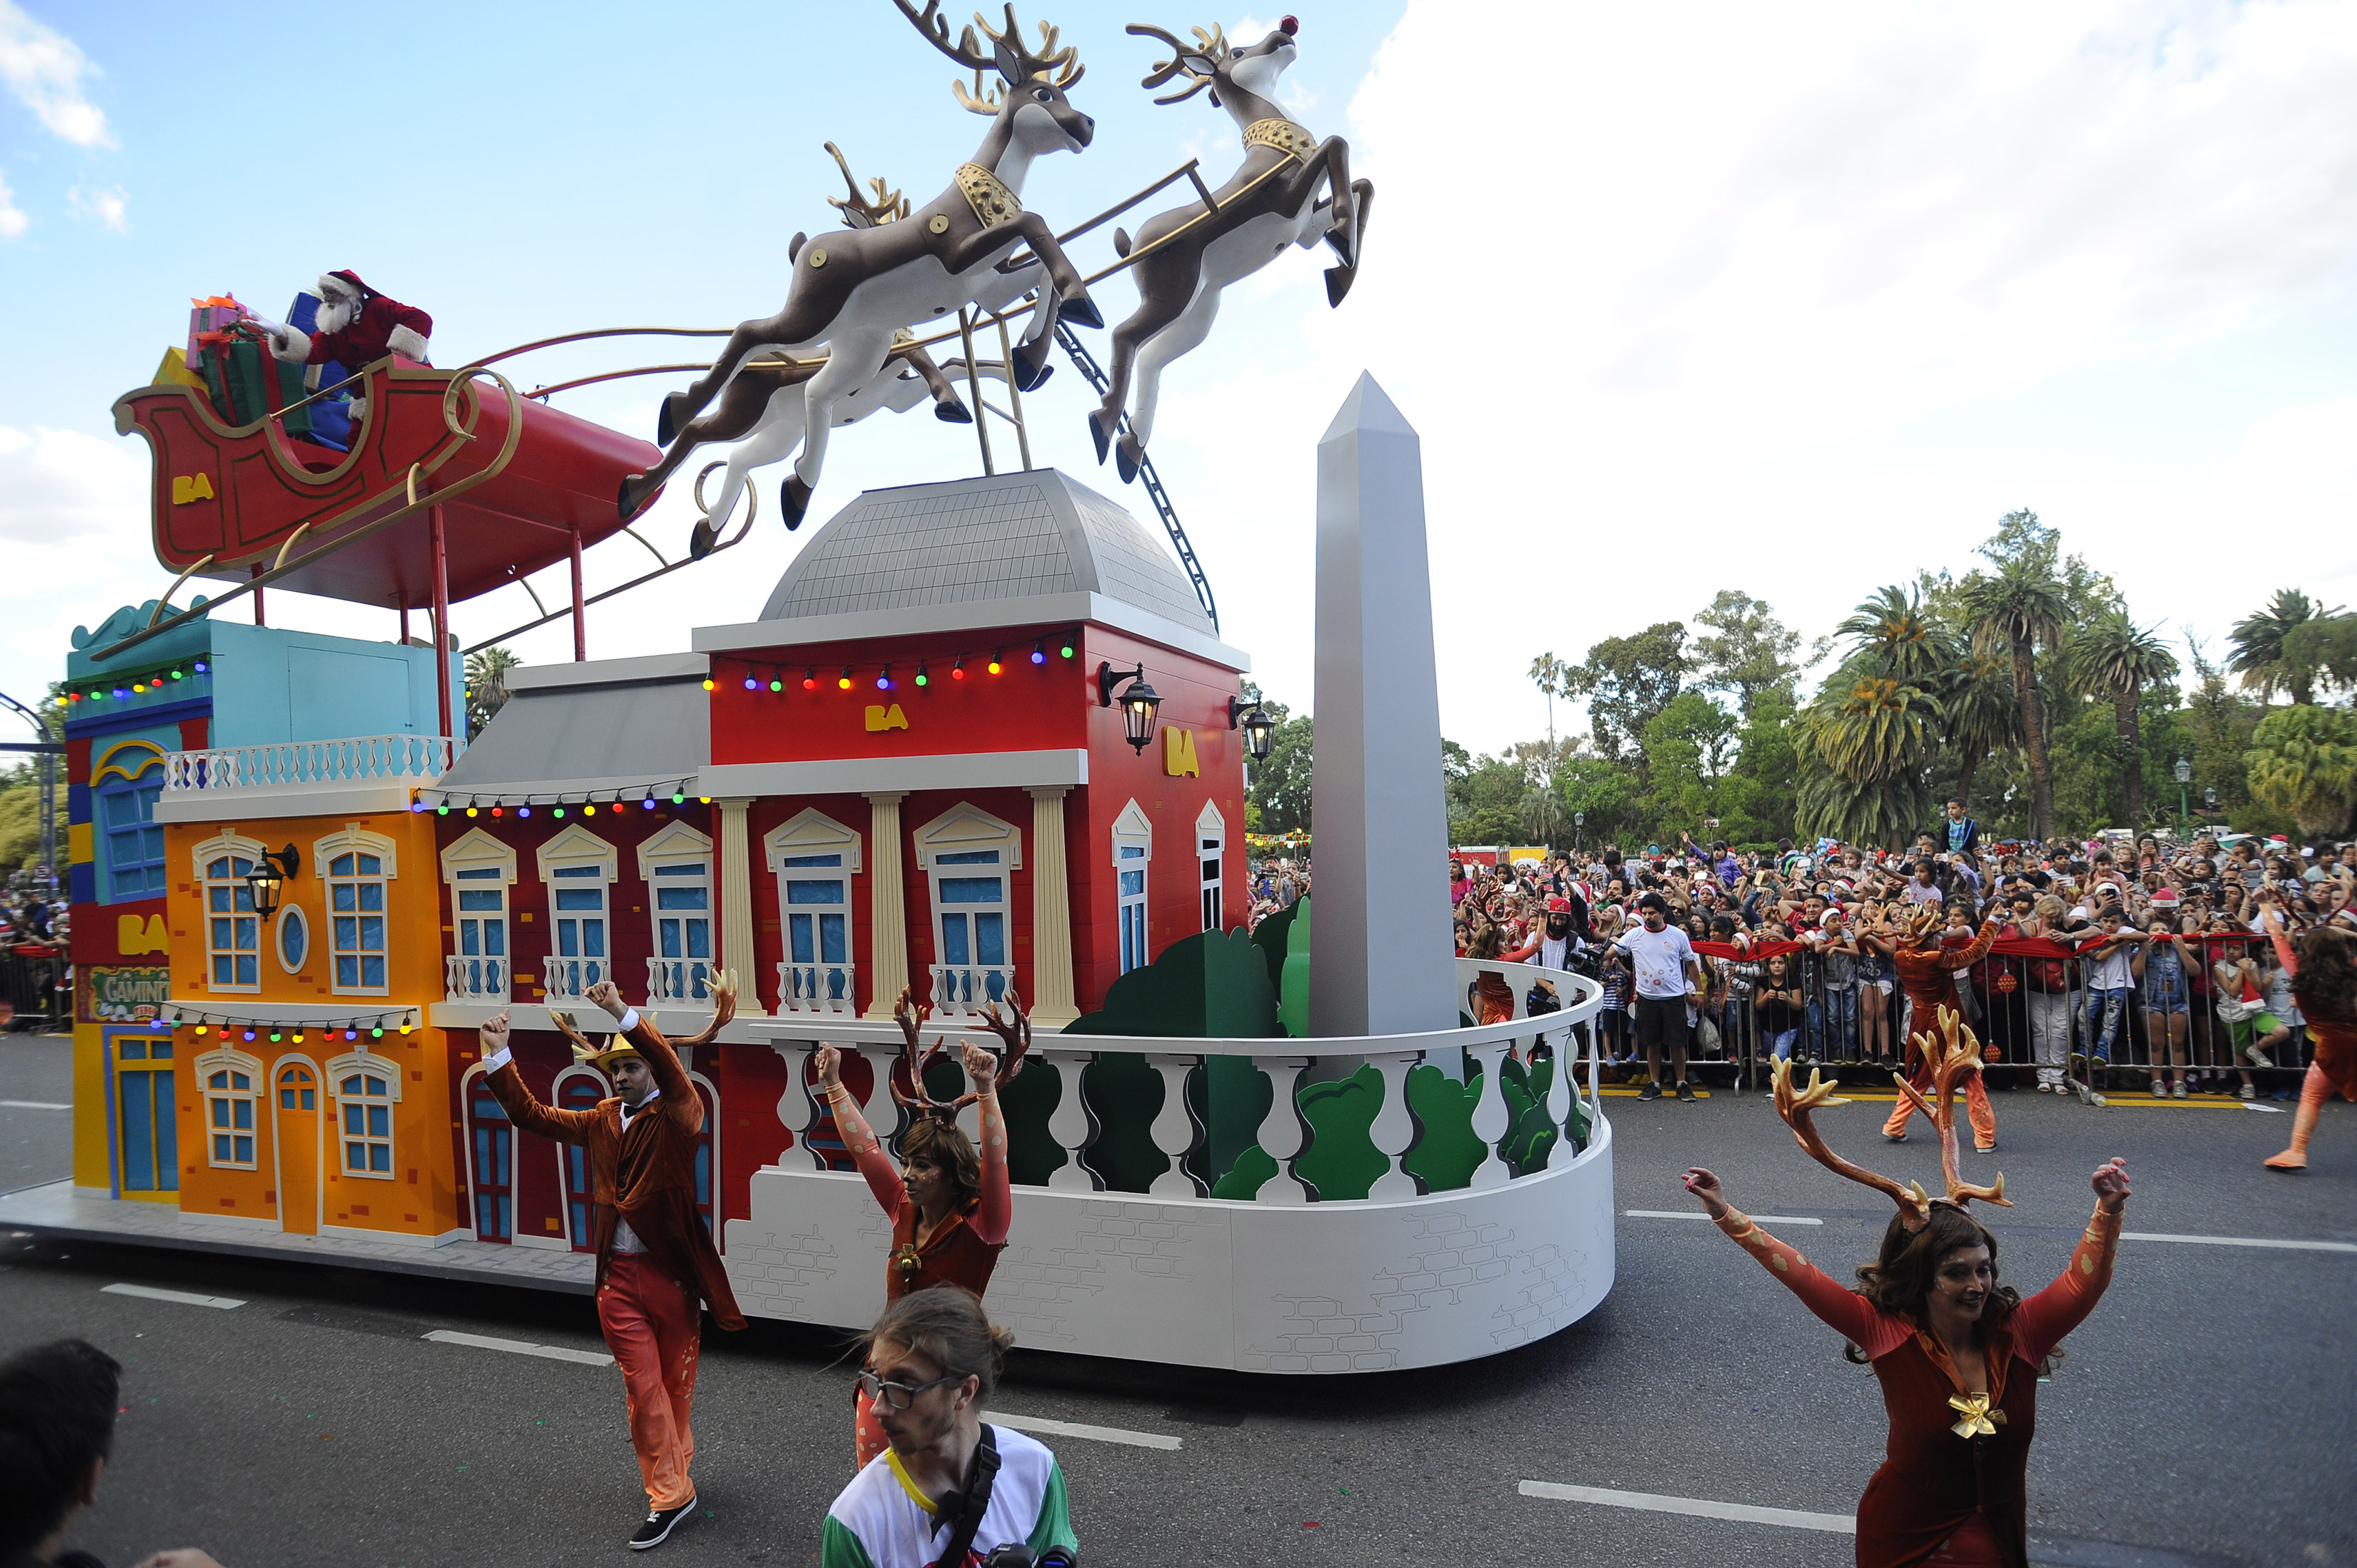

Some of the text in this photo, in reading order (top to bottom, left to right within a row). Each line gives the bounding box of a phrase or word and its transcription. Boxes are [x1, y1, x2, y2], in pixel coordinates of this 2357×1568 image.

[172, 472, 214, 505] BA
[865, 703, 909, 732] BA
[1164, 725, 1200, 778] BA
[118, 914, 170, 956] BA
